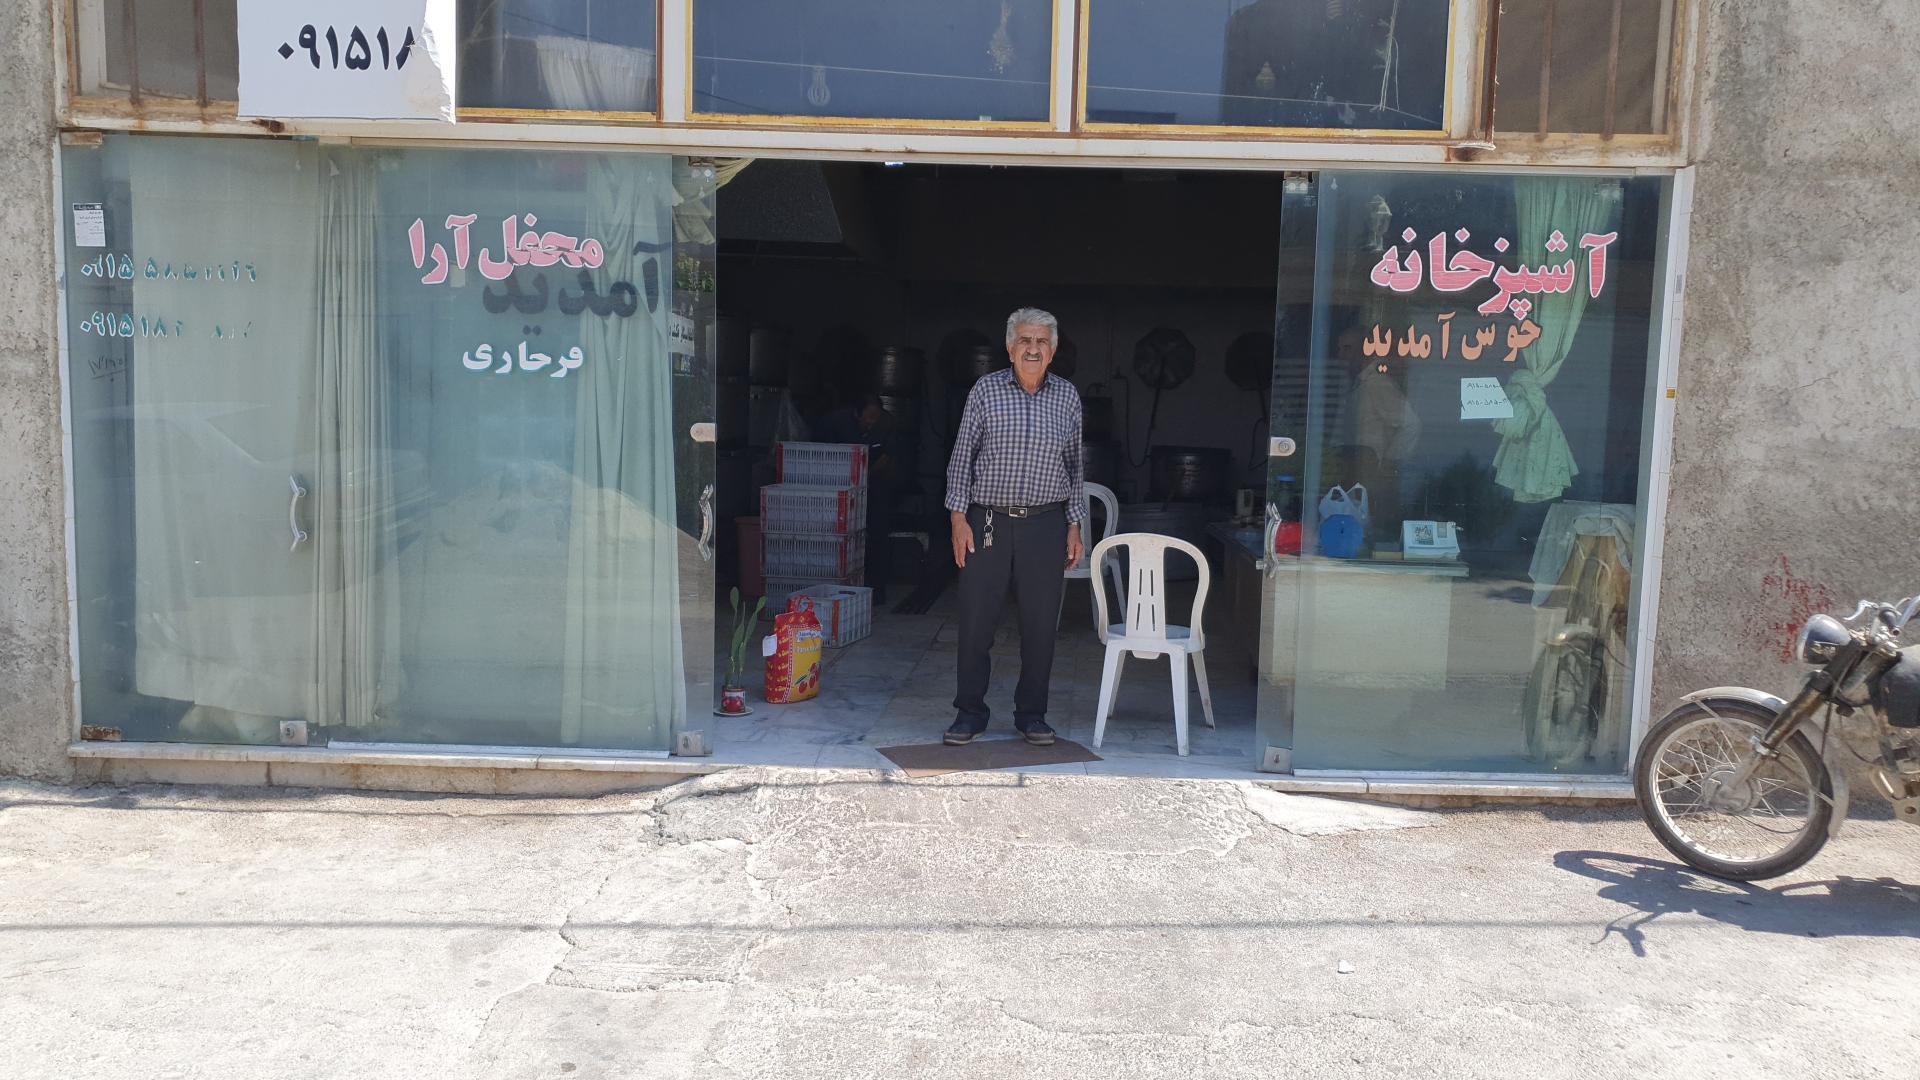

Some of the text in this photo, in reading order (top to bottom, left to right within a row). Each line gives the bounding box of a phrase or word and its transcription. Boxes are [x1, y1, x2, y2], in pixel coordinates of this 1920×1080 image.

[408, 213, 604, 285] محفل آرا
[1371, 226, 1618, 320] آشپزخانه
[1362, 311, 1456, 373] آمدید
